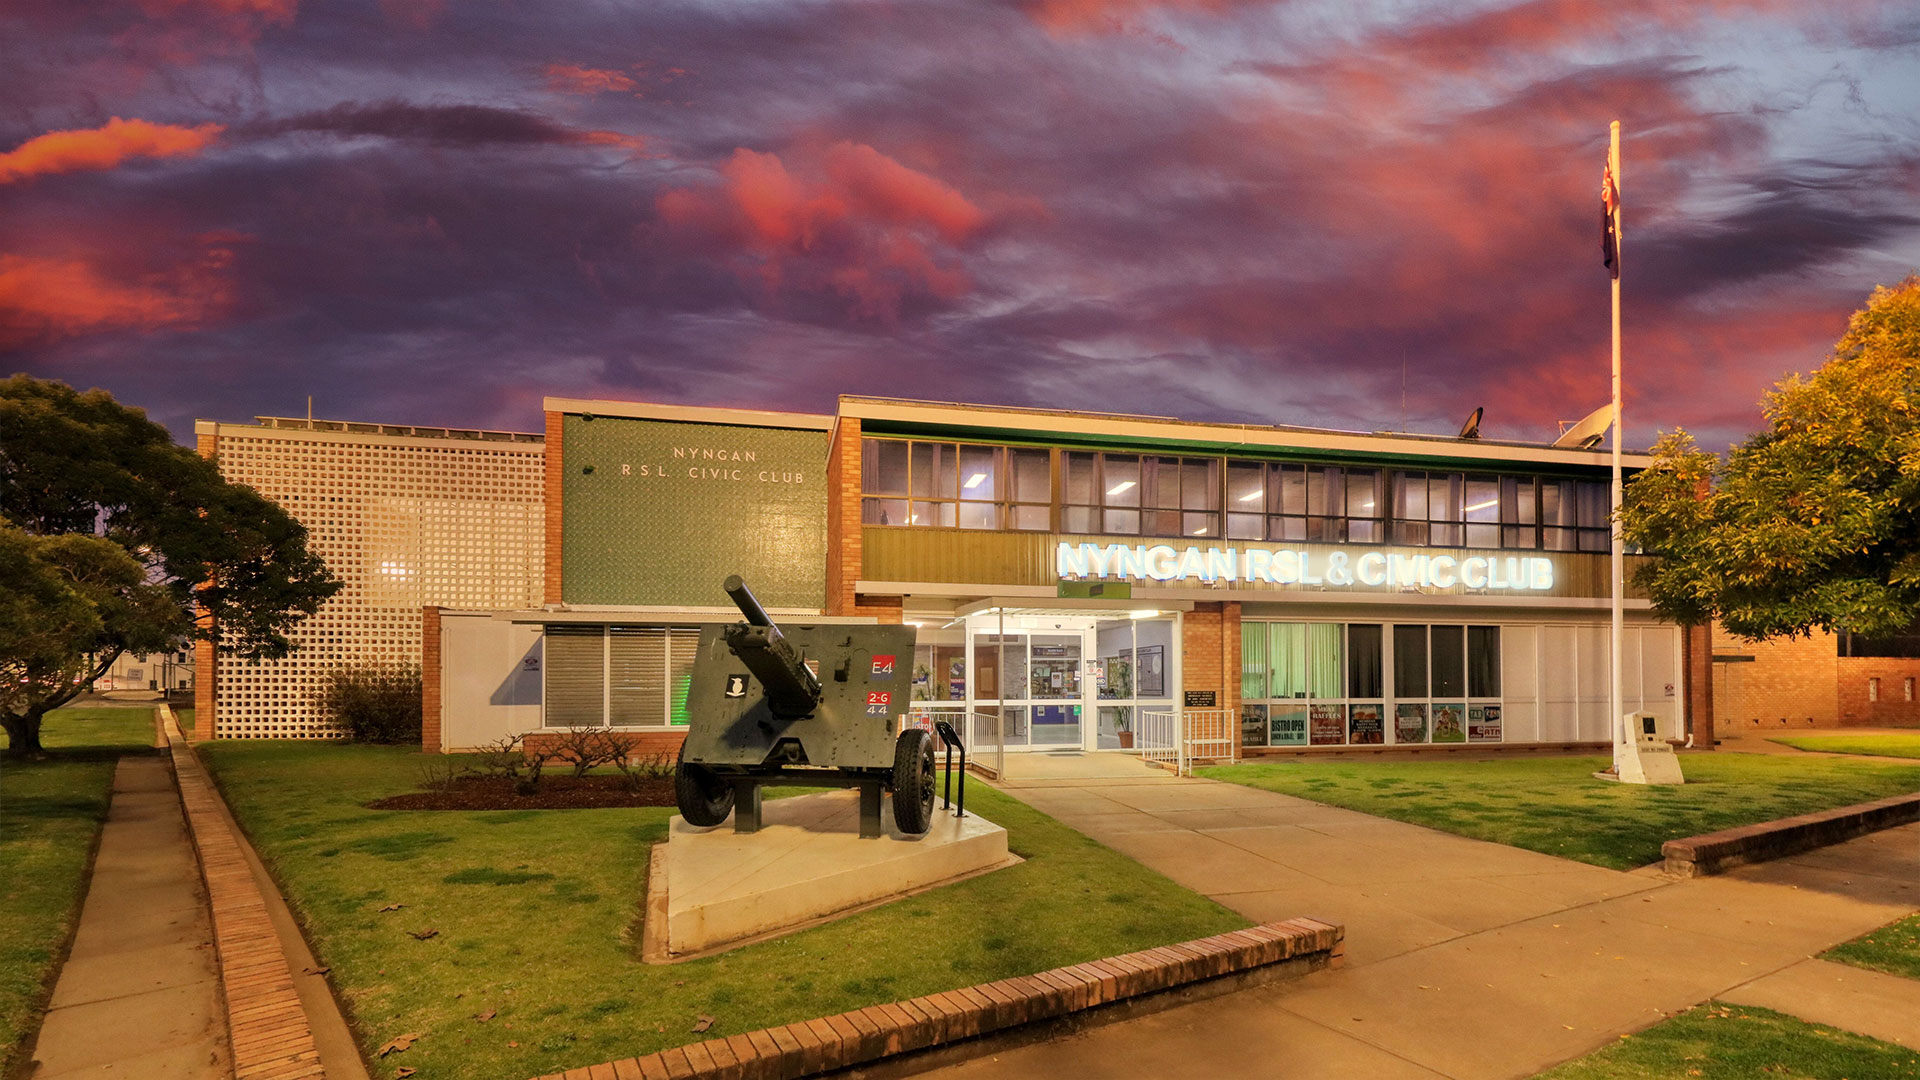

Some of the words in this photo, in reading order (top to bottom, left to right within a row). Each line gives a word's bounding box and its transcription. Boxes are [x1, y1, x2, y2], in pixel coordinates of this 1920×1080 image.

[673, 447, 756, 463] NYNGAN
[688, 467, 742, 481] CIVIC
[758, 471, 803, 484] CLUB
[1057, 542, 1237, 582] NYNGAN
[1245, 548, 1323, 584] RSL
[1326, 551, 1355, 586] &
[1357, 552, 1457, 588] CIVIC
[1460, 557, 1554, 590] CLUB
[872, 661, 893, 674] E4
[1470, 710, 1482, 719] TAB
